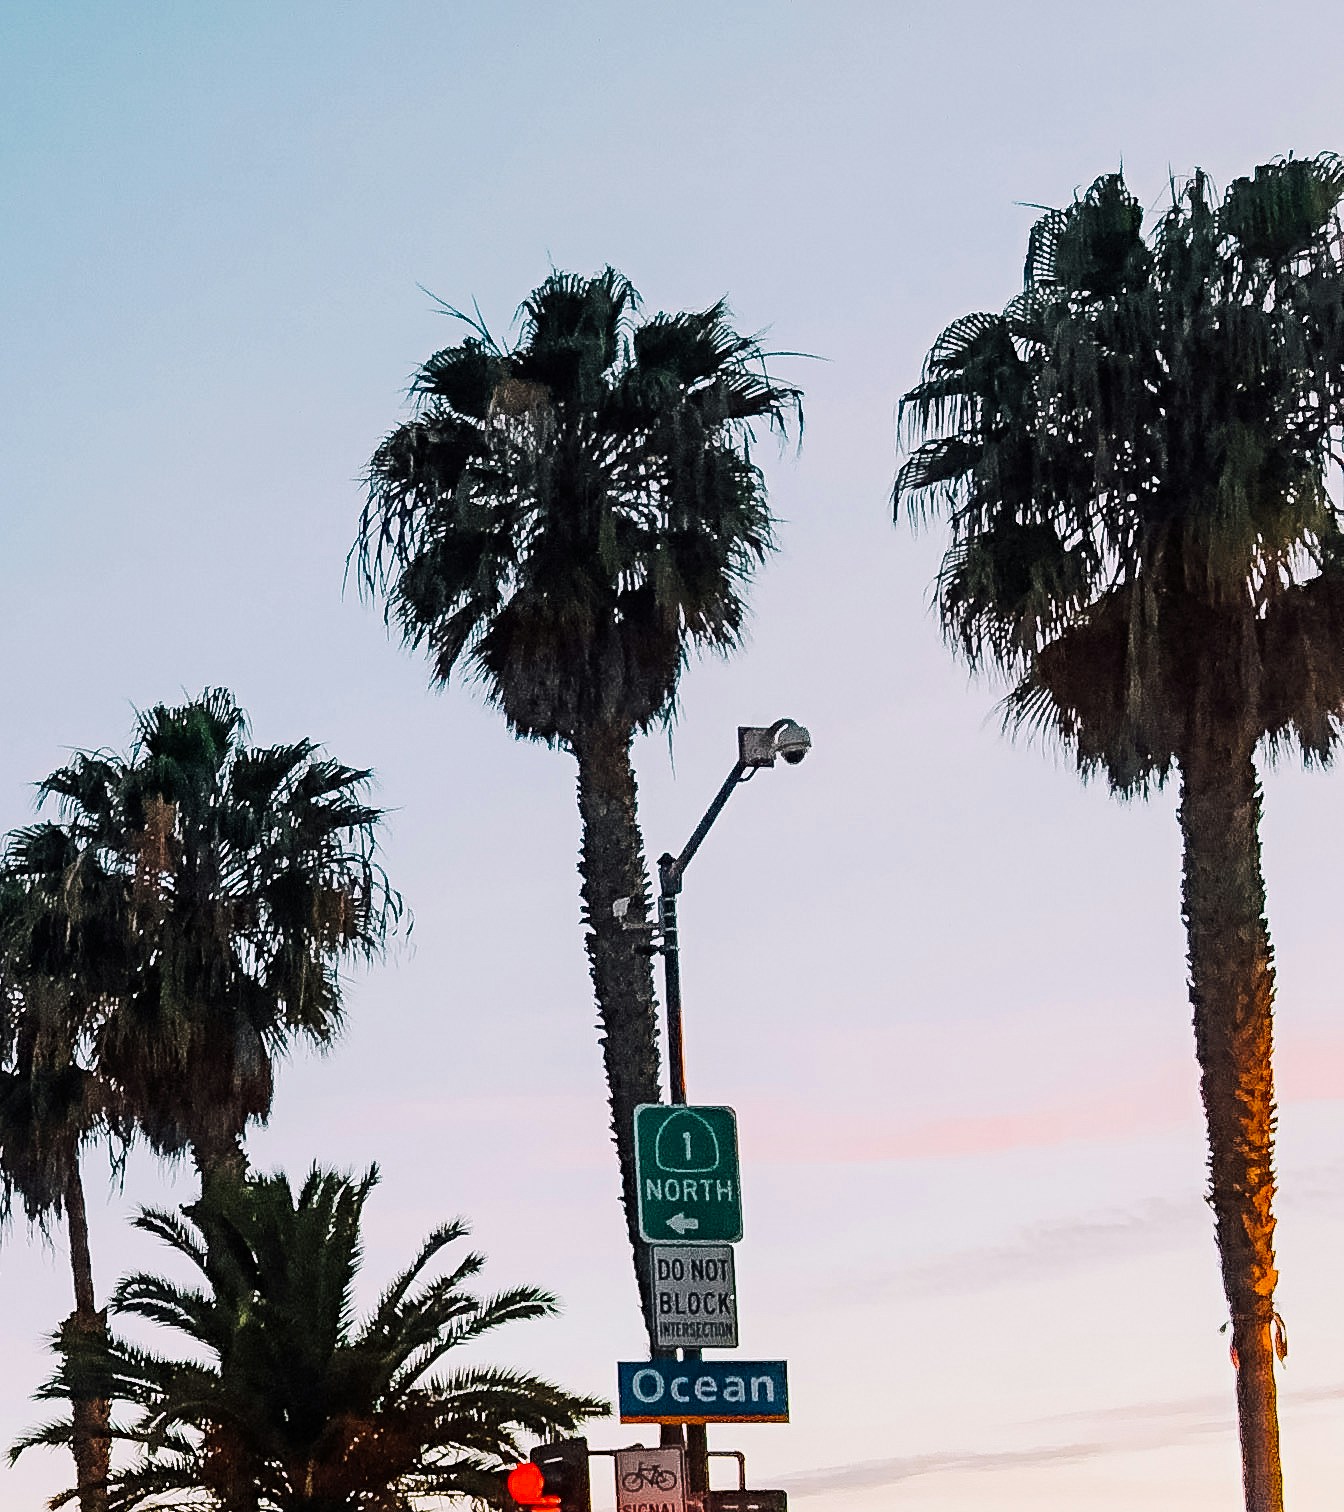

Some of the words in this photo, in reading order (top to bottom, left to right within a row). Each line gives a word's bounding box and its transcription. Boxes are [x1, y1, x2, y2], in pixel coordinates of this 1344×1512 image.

[682, 1131, 692, 1160] 1
[646, 1179, 732, 1201] NORTH
[658, 1258, 684, 1281] DO
[691, 1258, 728, 1281] NOT
[659, 1292, 731, 1315] BLOCK
[659, 1321, 733, 1338] INTERSECTION
[632, 1368, 775, 1403] Ocean
